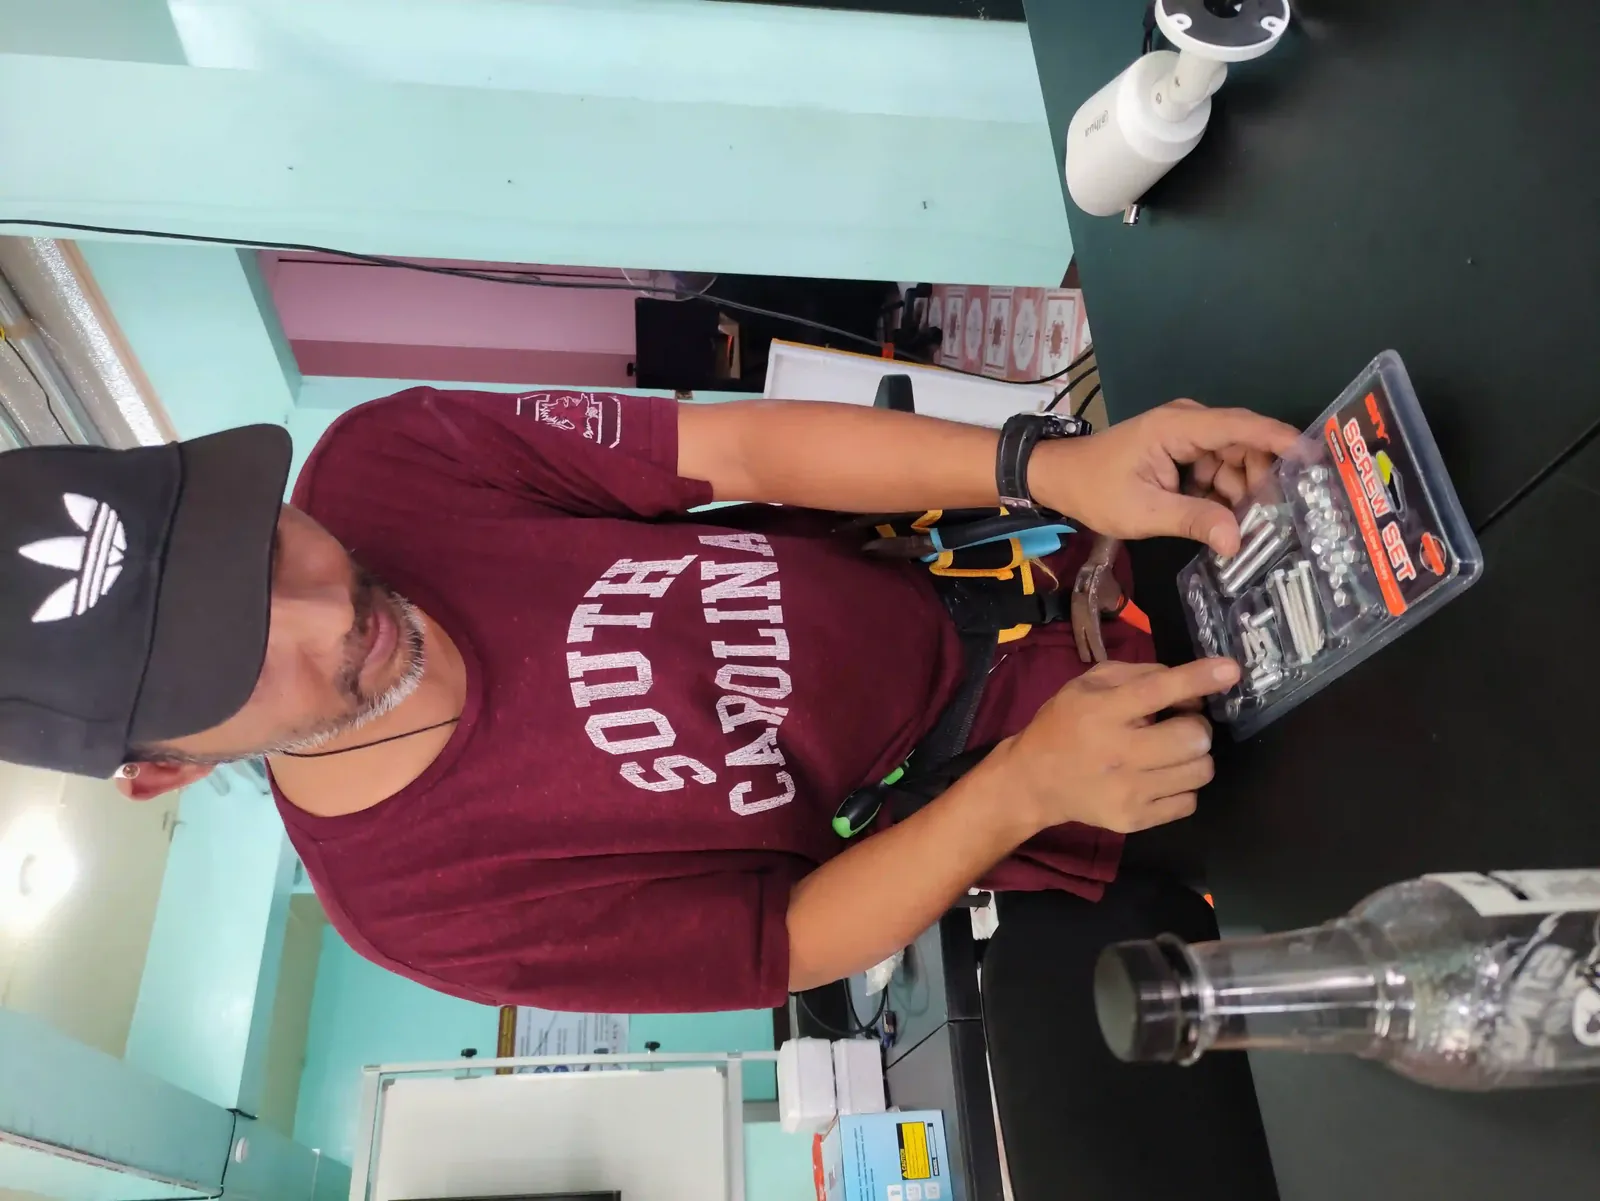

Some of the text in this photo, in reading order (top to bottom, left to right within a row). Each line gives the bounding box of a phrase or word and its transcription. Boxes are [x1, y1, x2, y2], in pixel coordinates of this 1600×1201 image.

[1343, 417, 1416, 582] SCREW SET
[1367, 531, 1378, 548] Low
[566, 555, 717, 792] SOUTH
[698, 533, 796, 816] CAROLINA
